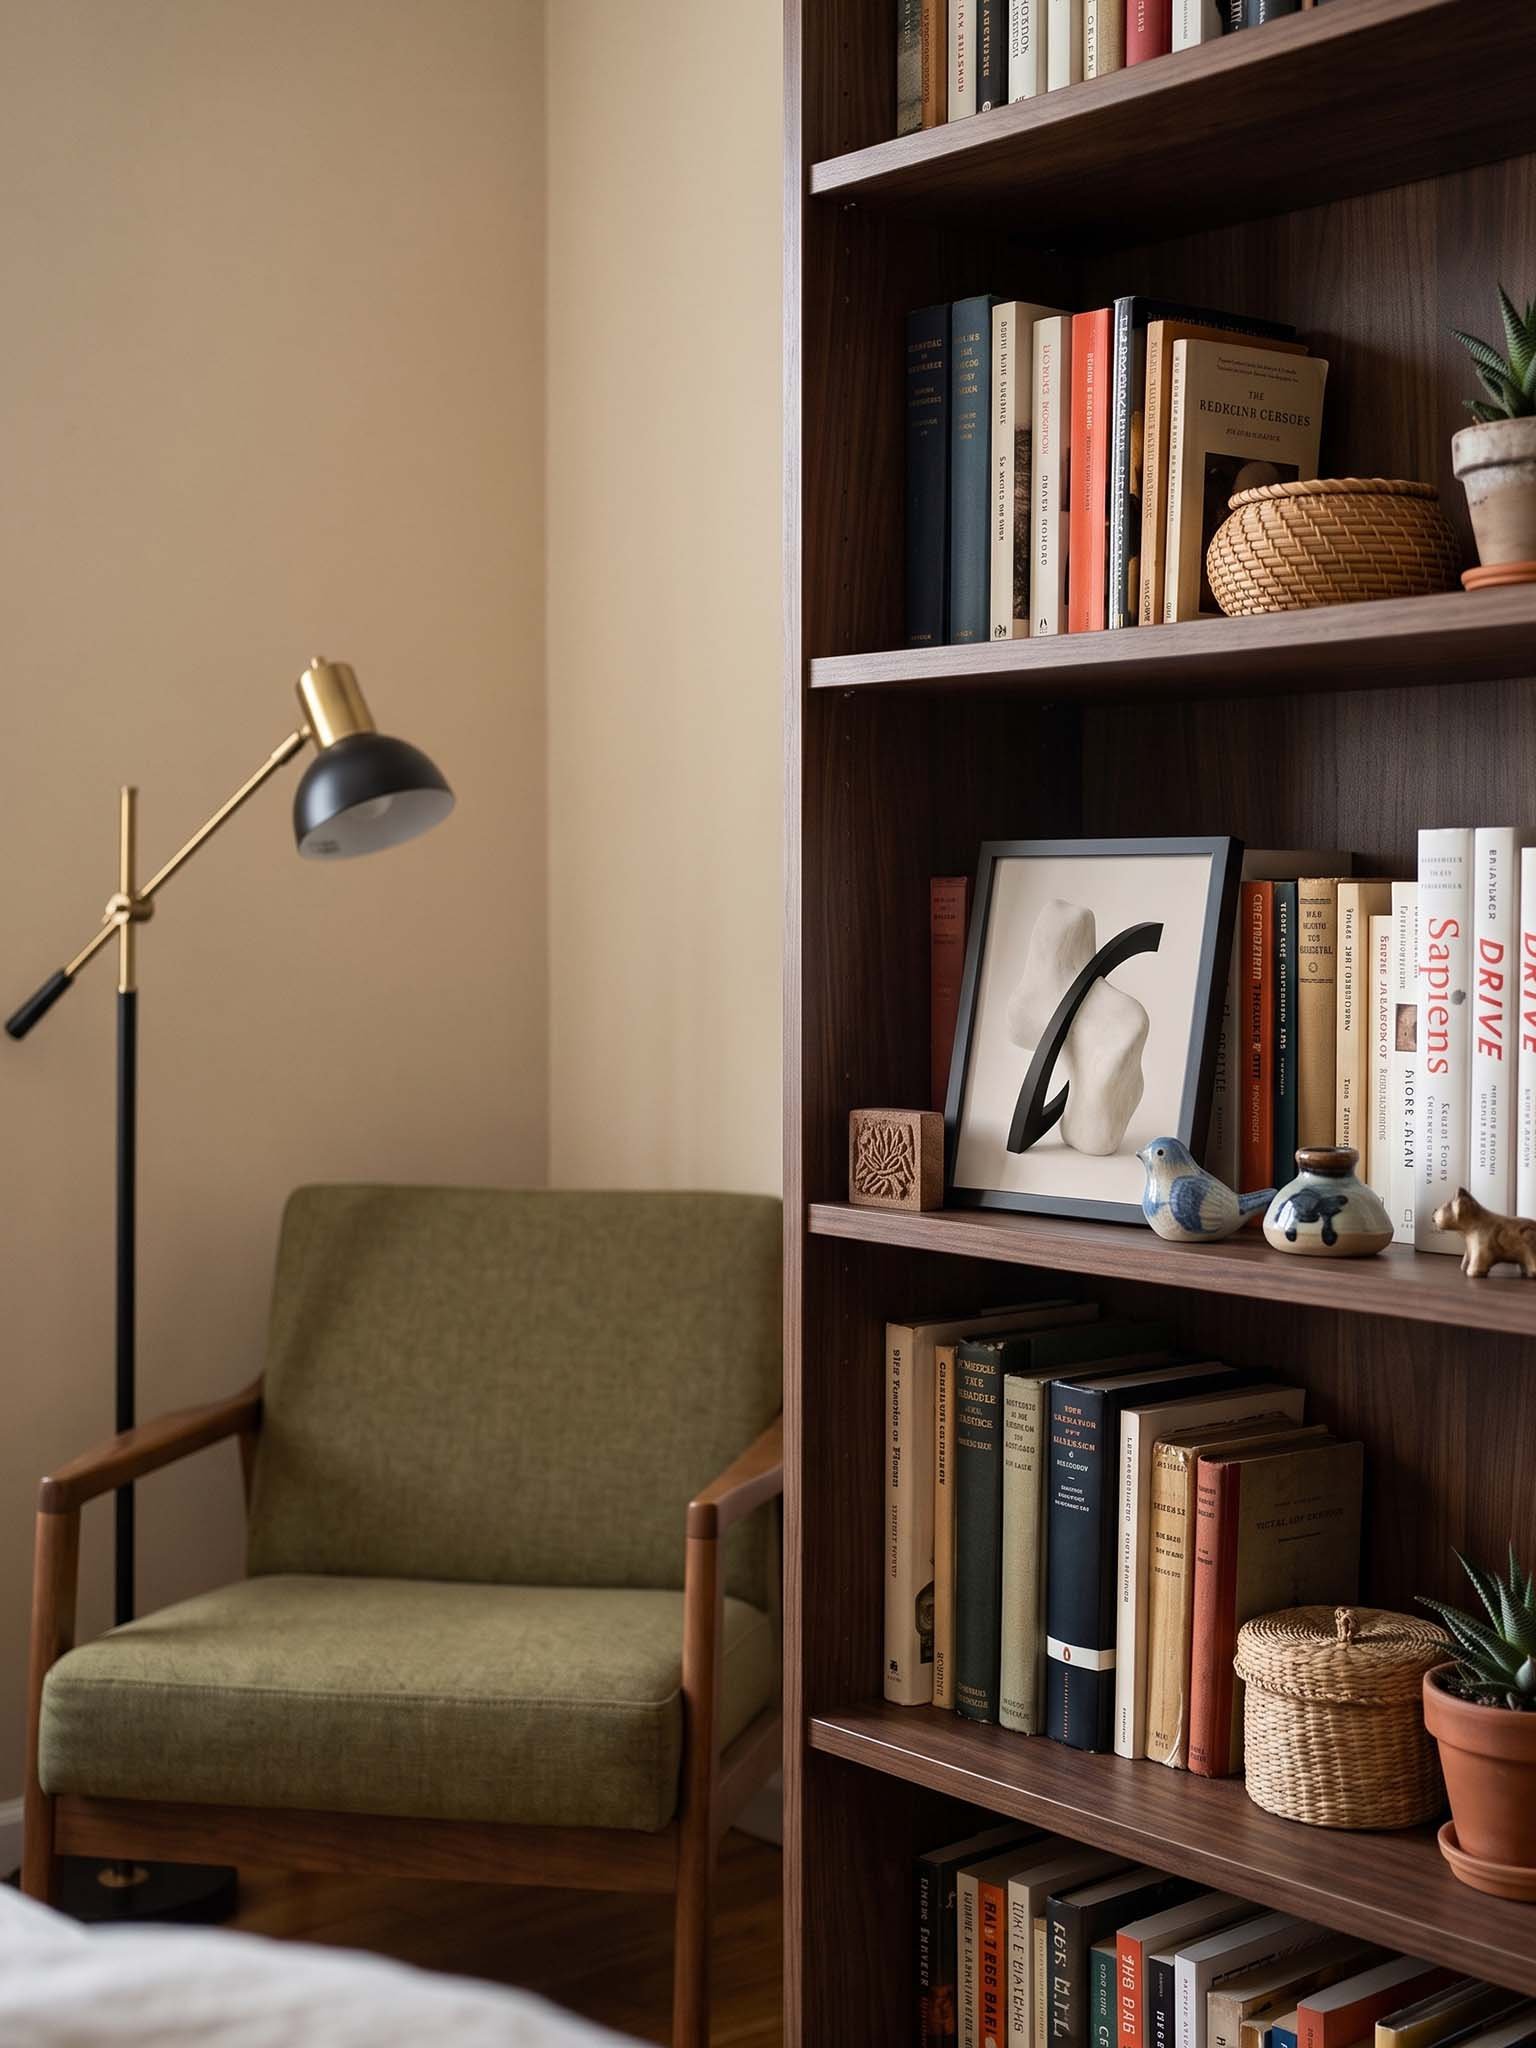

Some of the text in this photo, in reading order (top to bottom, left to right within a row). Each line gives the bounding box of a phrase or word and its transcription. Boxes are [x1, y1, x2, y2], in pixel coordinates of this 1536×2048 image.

[1248, 391, 1265, 400] THE
[1418, 918, 1460, 1074] Sapiens
[1478, 938, 1505, 1061] DRIVE
